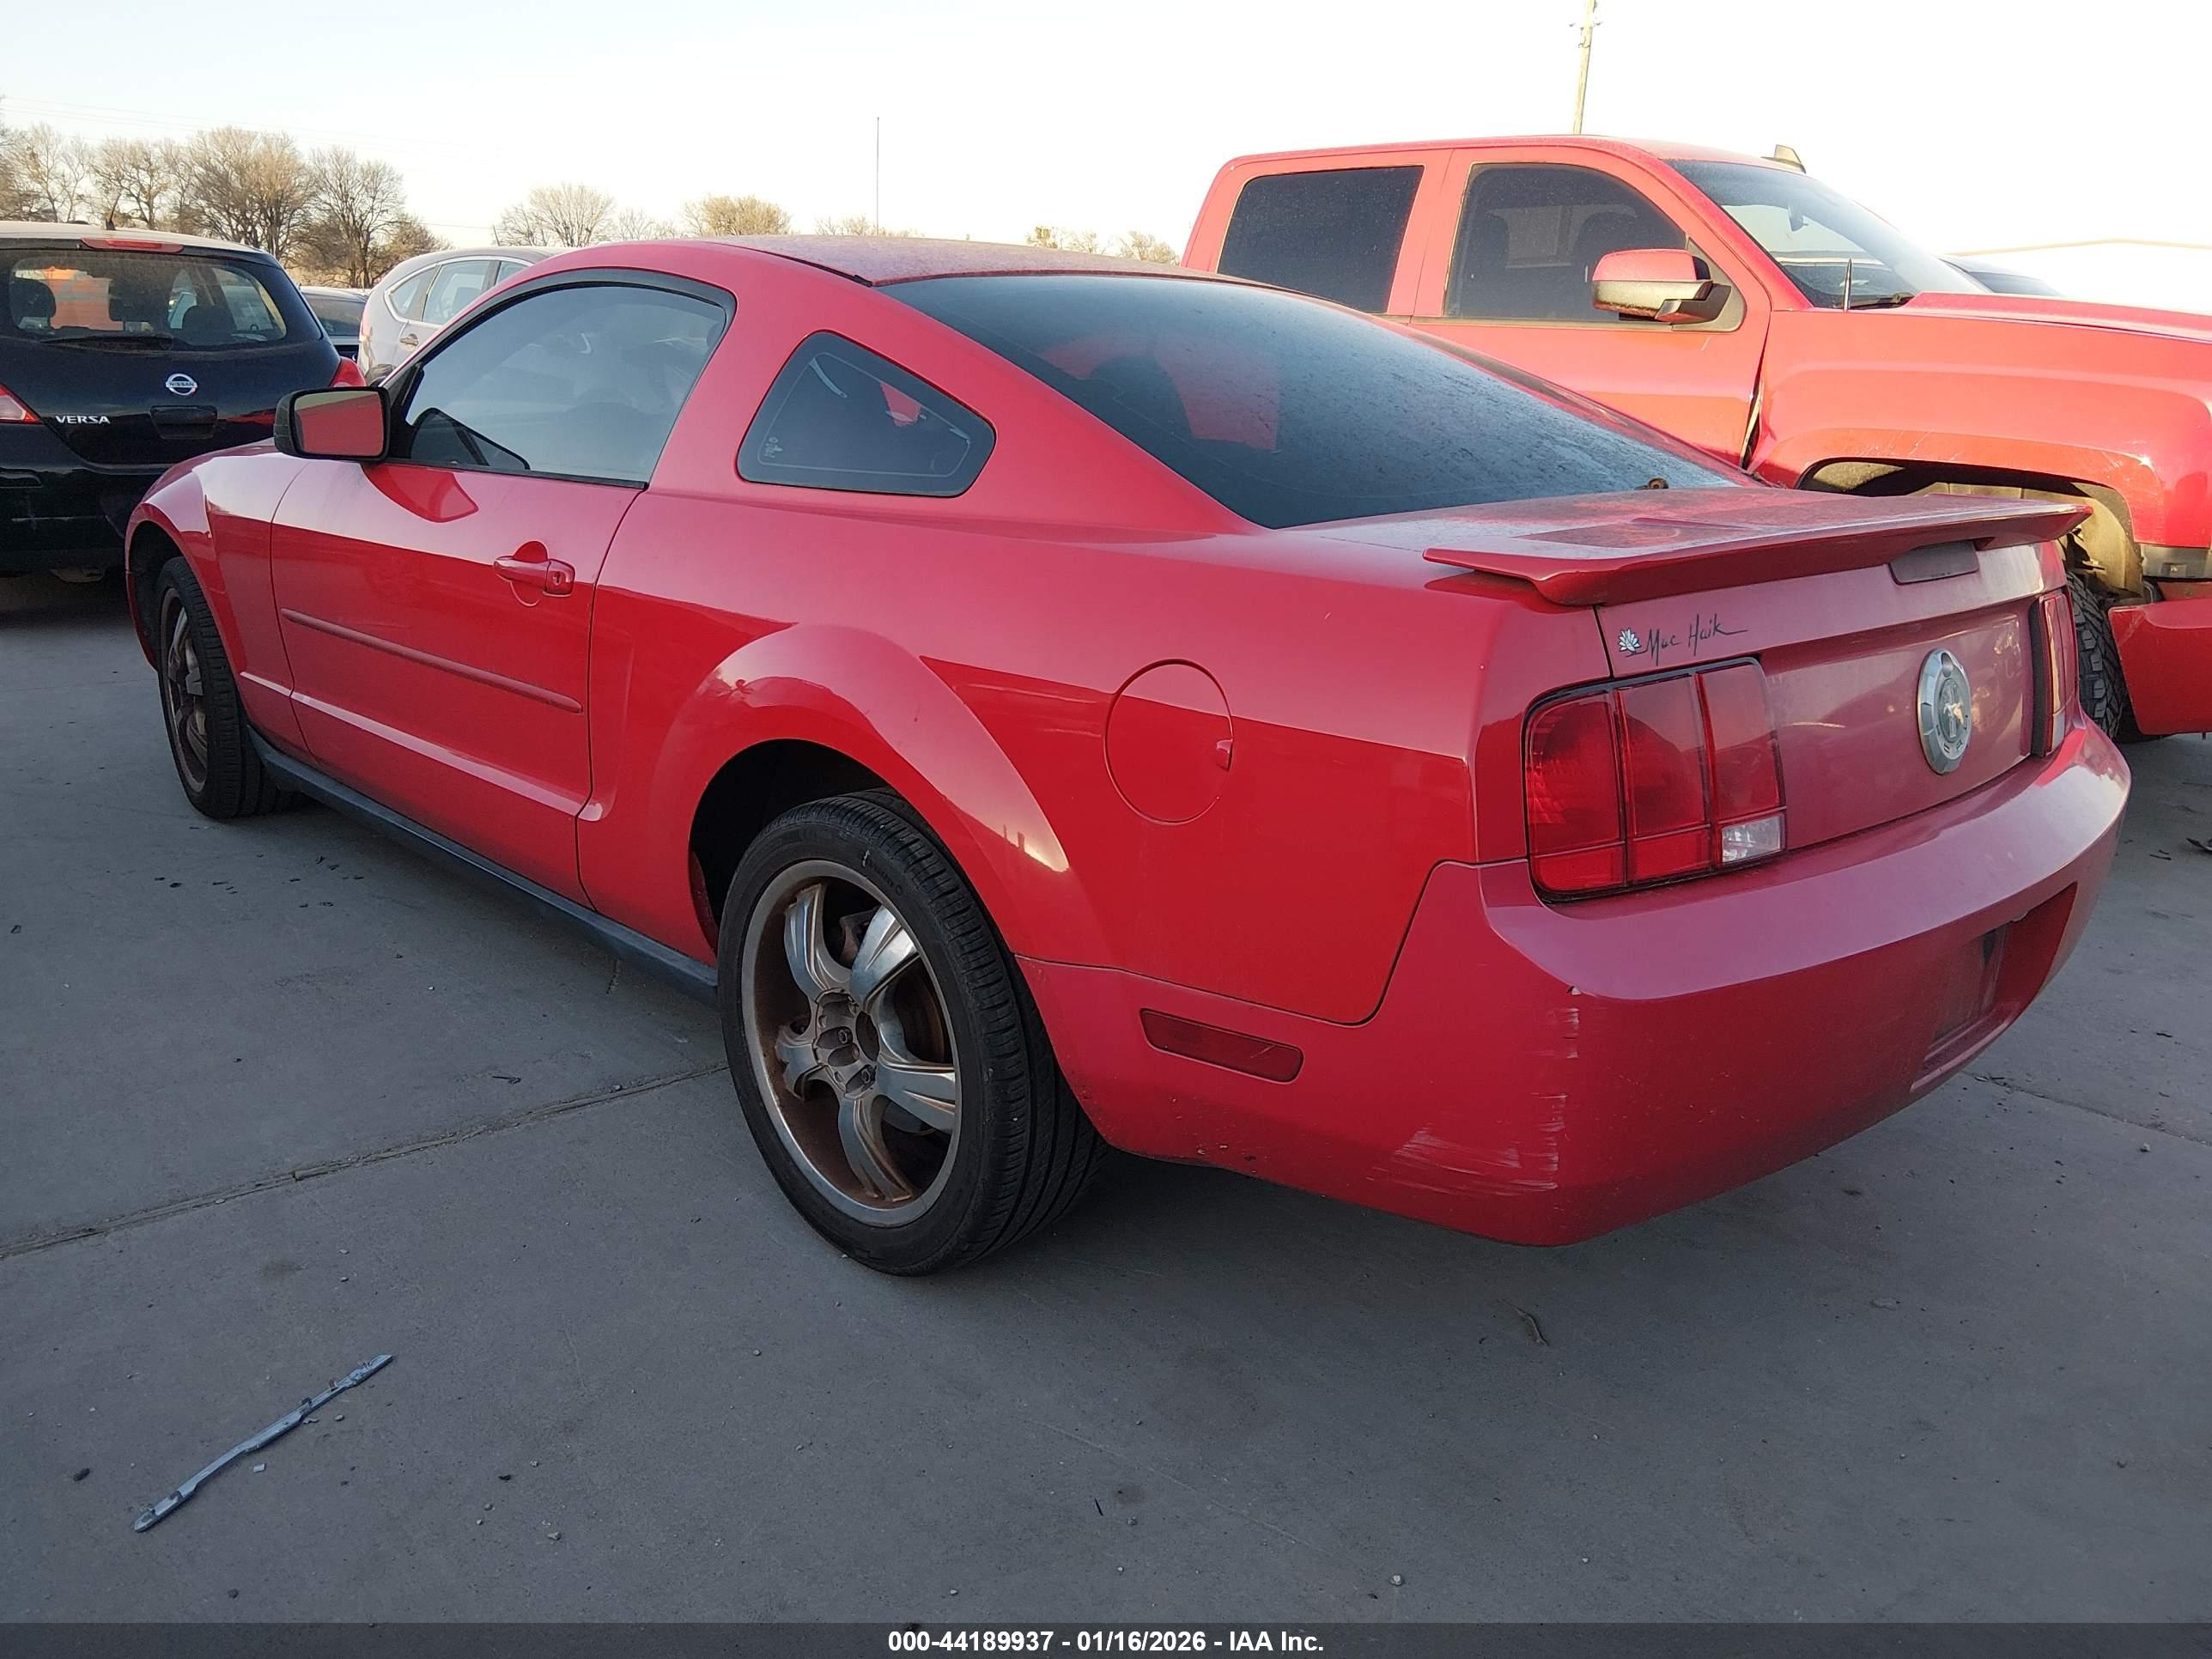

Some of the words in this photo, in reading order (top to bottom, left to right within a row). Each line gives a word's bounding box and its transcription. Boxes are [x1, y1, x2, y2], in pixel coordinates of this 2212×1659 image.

[55, 415, 111, 424] VERSA
[1626, 629, 1680, 666] Mac
[1687, 613, 1748, 657] Haik
